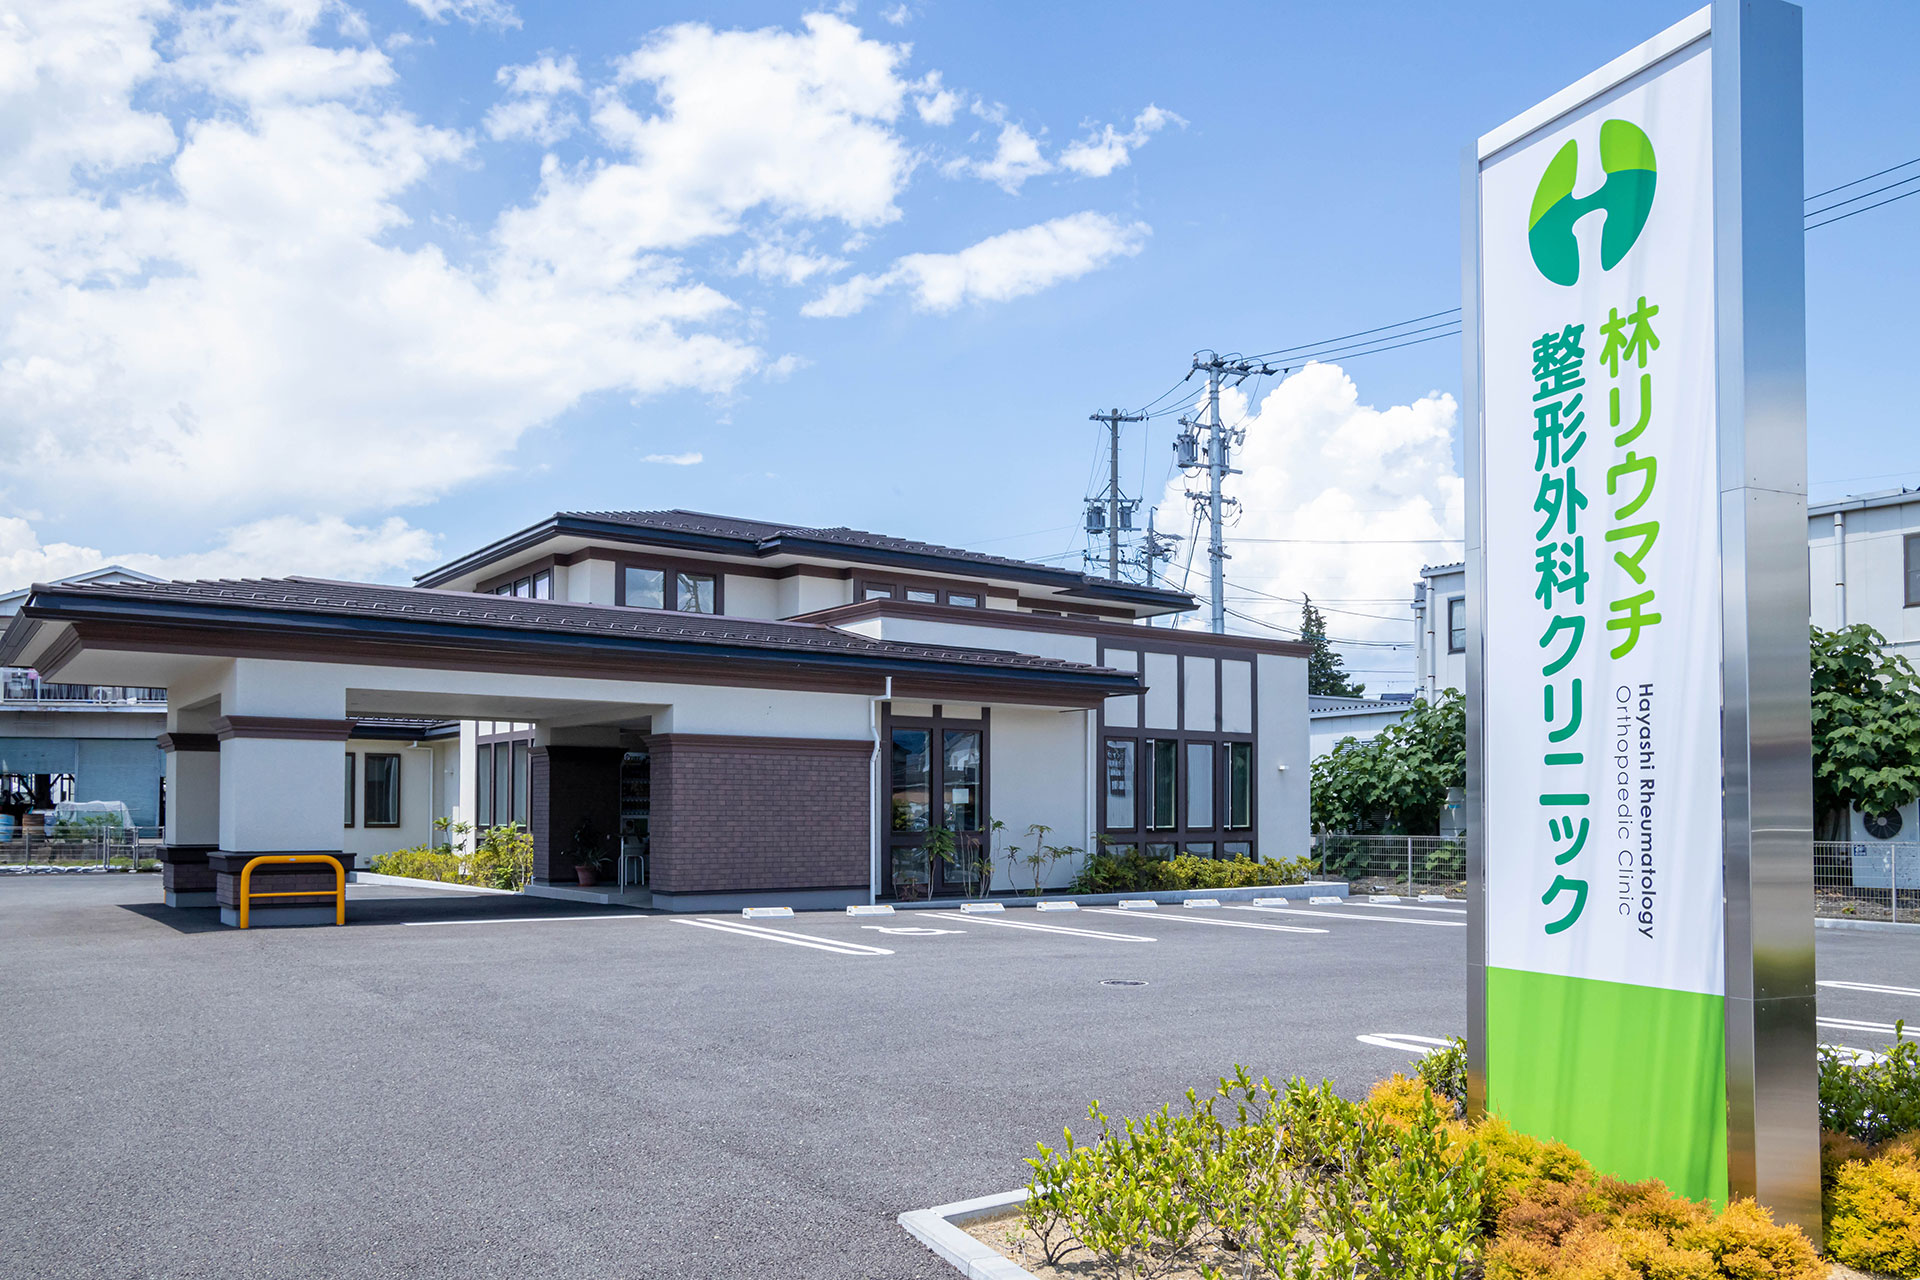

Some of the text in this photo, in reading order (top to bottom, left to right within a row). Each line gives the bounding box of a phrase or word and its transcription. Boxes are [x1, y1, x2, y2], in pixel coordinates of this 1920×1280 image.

[1531, 323, 1590, 935] 整形外科クリニック
[1599, 296, 1662, 660] 林リウマチ
[1614, 685, 1634, 916] Orthopaedic Clinic
[1636, 683, 1657, 940] Hayashi Rheumatology
